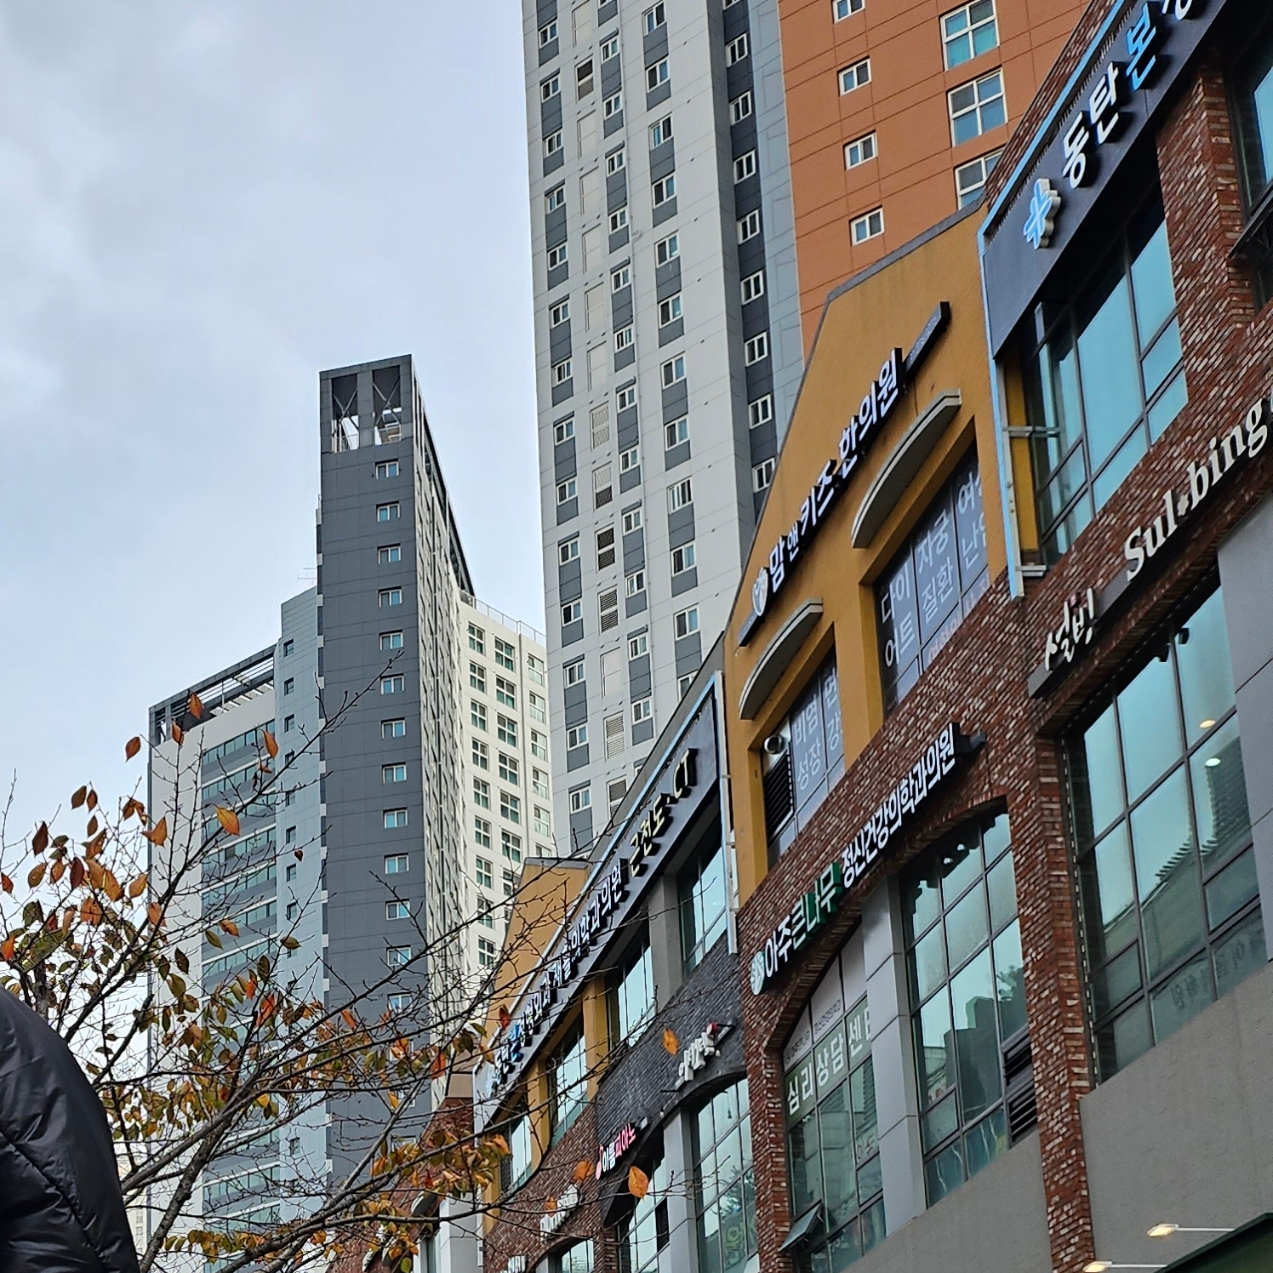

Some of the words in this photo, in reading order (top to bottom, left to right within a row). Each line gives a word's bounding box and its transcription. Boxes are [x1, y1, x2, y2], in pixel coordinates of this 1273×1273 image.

[1062, 0, 1193, 190] 동탄본
[768, 348, 900, 593] 맘앤키즈한의원
[917, 509, 950, 573] 자궁
[881, 566, 911, 623] 다이
[921, 557, 955, 625] 질환
[884, 616, 916, 668] 어트
[792, 699, 820, 746] 비염
[796, 743, 822, 793] 성장
[763, 860, 840, 978] 아주큰나무
[841, 724, 956, 889] 정신건강의학과의원
